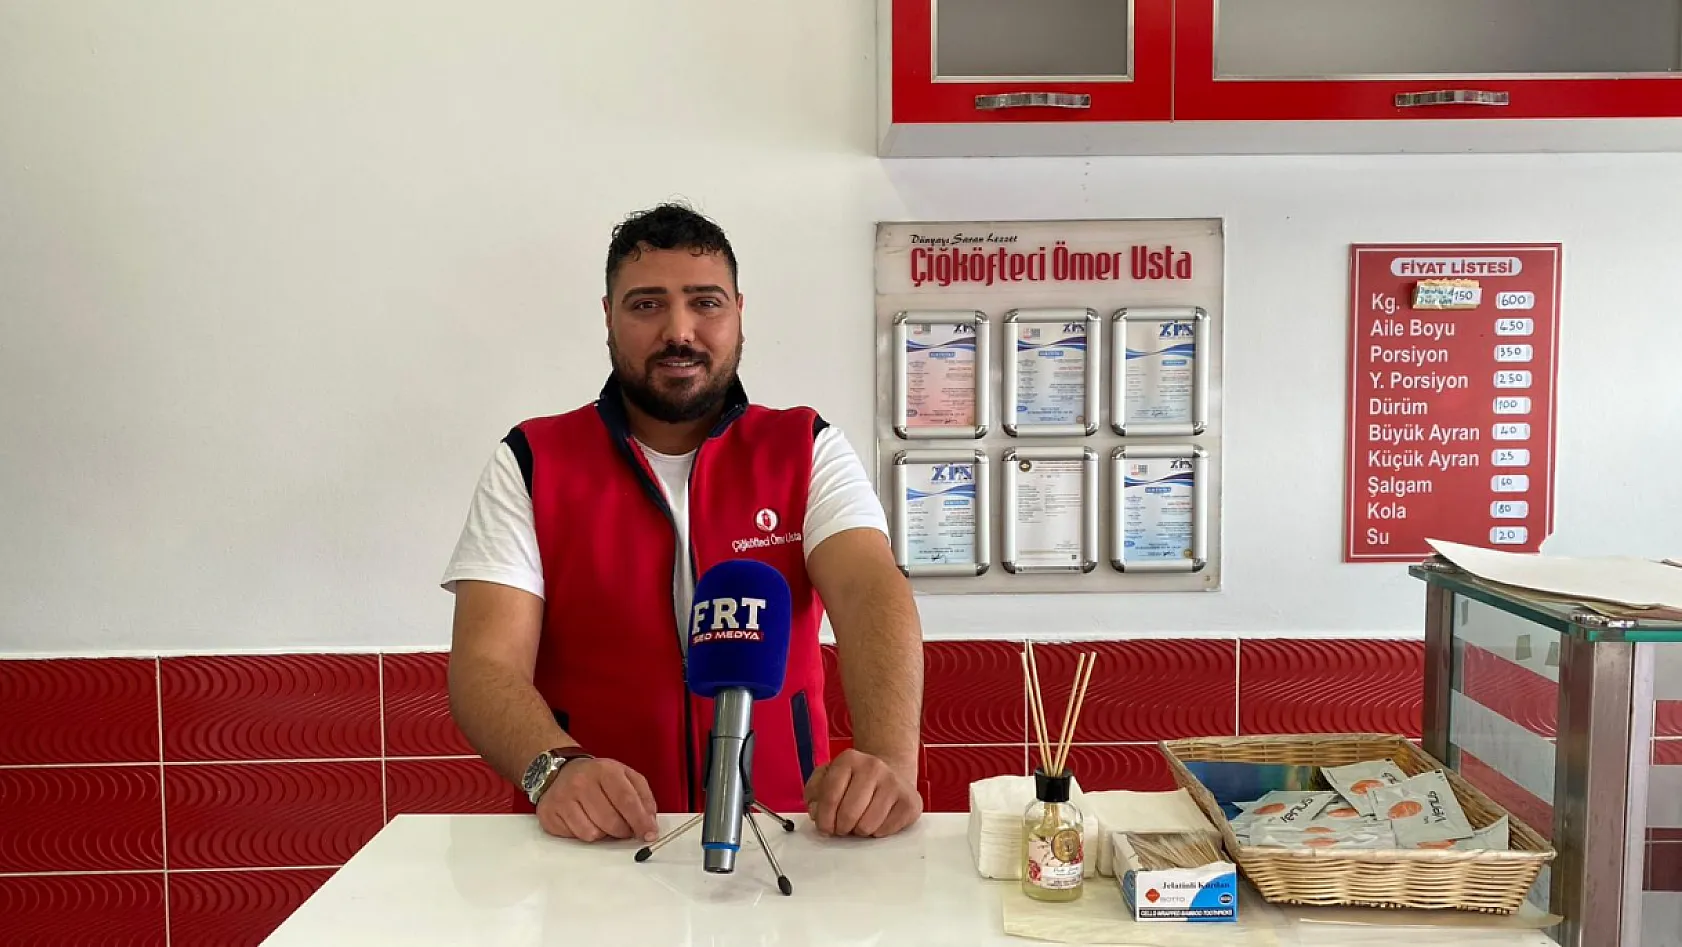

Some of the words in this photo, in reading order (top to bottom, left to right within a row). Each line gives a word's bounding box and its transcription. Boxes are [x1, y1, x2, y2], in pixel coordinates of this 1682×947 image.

[986, 232, 1018, 243] Lezzet
[911, 246, 1046, 287] Çiğköfteci
[1053, 241, 1121, 281] Ömer
[1131, 245, 1192, 280] Usta
[1401, 259, 1446, 274] FİYAT
[1451, 259, 1513, 274] LİSTESİ
[1372, 293, 1400, 314] Kg.
[1454, 290, 1473, 301] 150
[1501, 294, 1526, 305] 600
[1370, 319, 1404, 336] Aile
[1409, 320, 1455, 340] Boyu
[1499, 321, 1524, 331] 450
[1370, 345, 1448, 367] Porsiyon
[1499, 347, 1521, 356] 350
[1370, 372, 1384, 388] Y.
[1390, 372, 1469, 393] Porsiyon
[1499, 374, 1523, 384] 250
[1369, 398, 1428, 415] Dürüm
[1498, 399, 1518, 410] 100
[1368, 424, 1425, 445] Büyük
[1429, 424, 1480, 445] Ayran
[1500, 426, 1517, 434] 40
[1368, 450, 1424, 472] Küçük
[1428, 450, 1480, 471] Ayran
[1499, 451, 1515, 461] 25
[1367, 475, 1433, 498] Şalgam
[1367, 502, 1407, 519] Kola
[1366, 528, 1389, 545] Su
[1499, 529, 1516, 539] 20
[692, 597, 767, 635] FRT
[714, 631, 760, 640] MEDYA
